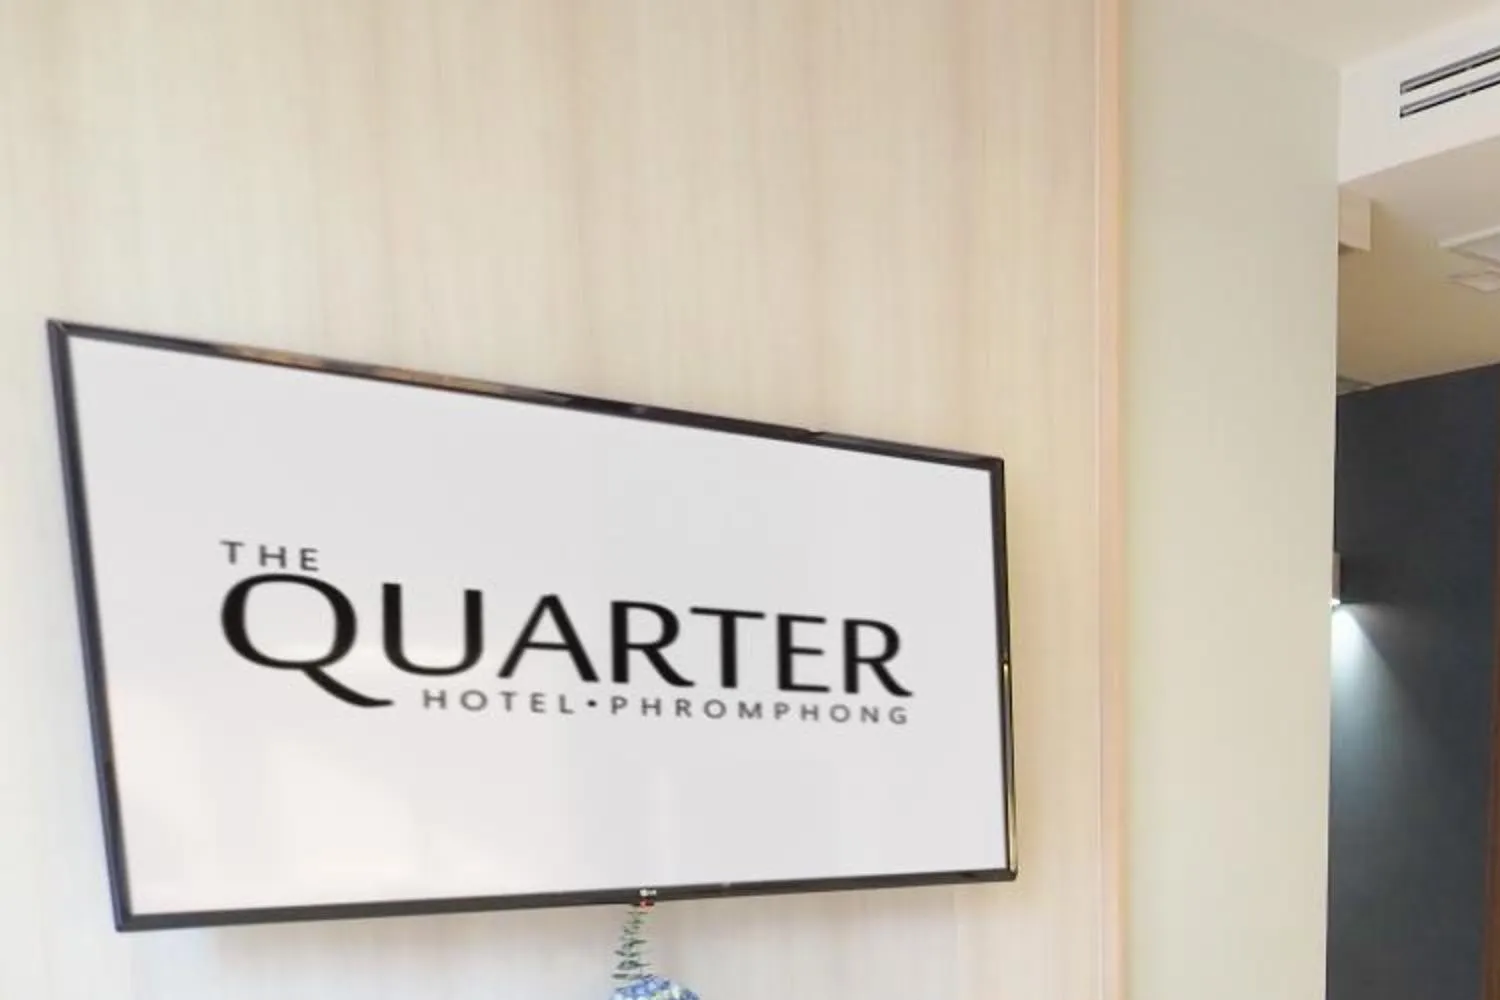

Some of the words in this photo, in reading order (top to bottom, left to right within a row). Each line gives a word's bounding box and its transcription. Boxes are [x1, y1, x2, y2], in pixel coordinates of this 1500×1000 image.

[220, 540, 319, 573] THE
[220, 572, 914, 708] QUARTER
[423, 688, 575, 715] HOTEL
[610, 695, 909, 726] PHROMPHONG
